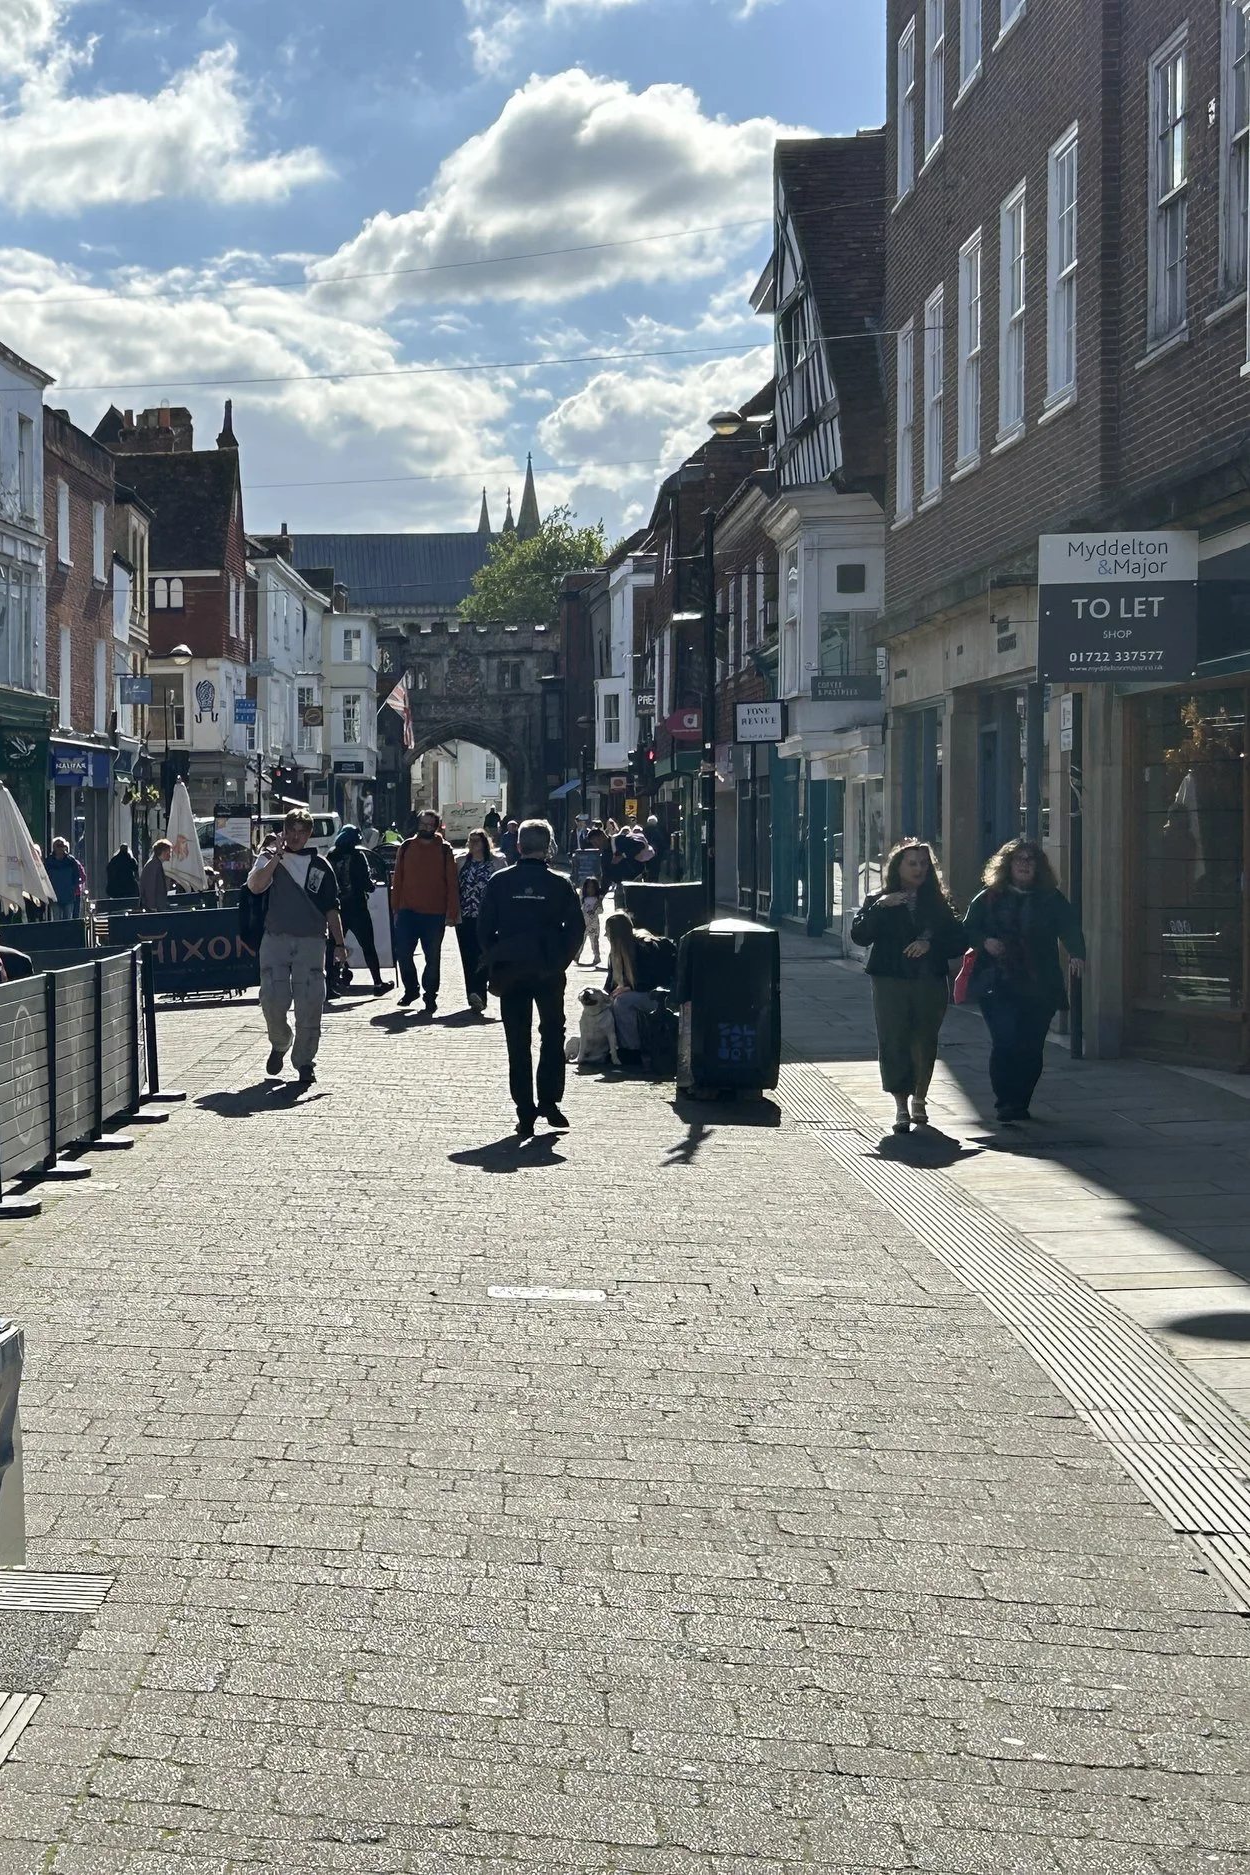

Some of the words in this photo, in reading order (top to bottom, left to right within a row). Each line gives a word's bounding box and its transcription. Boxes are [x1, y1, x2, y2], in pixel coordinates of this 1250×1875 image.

[1068, 538, 1168, 561] Myddelton
[1071, 598, 1111, 619] TO
[1119, 596, 1165, 618] LET
[1102, 629, 1133, 639] SHOP
[1069, 652, 1110, 662] 01722
[1114, 650, 1164, 662] 337577
[741, 716, 778, 725] REVIVE
